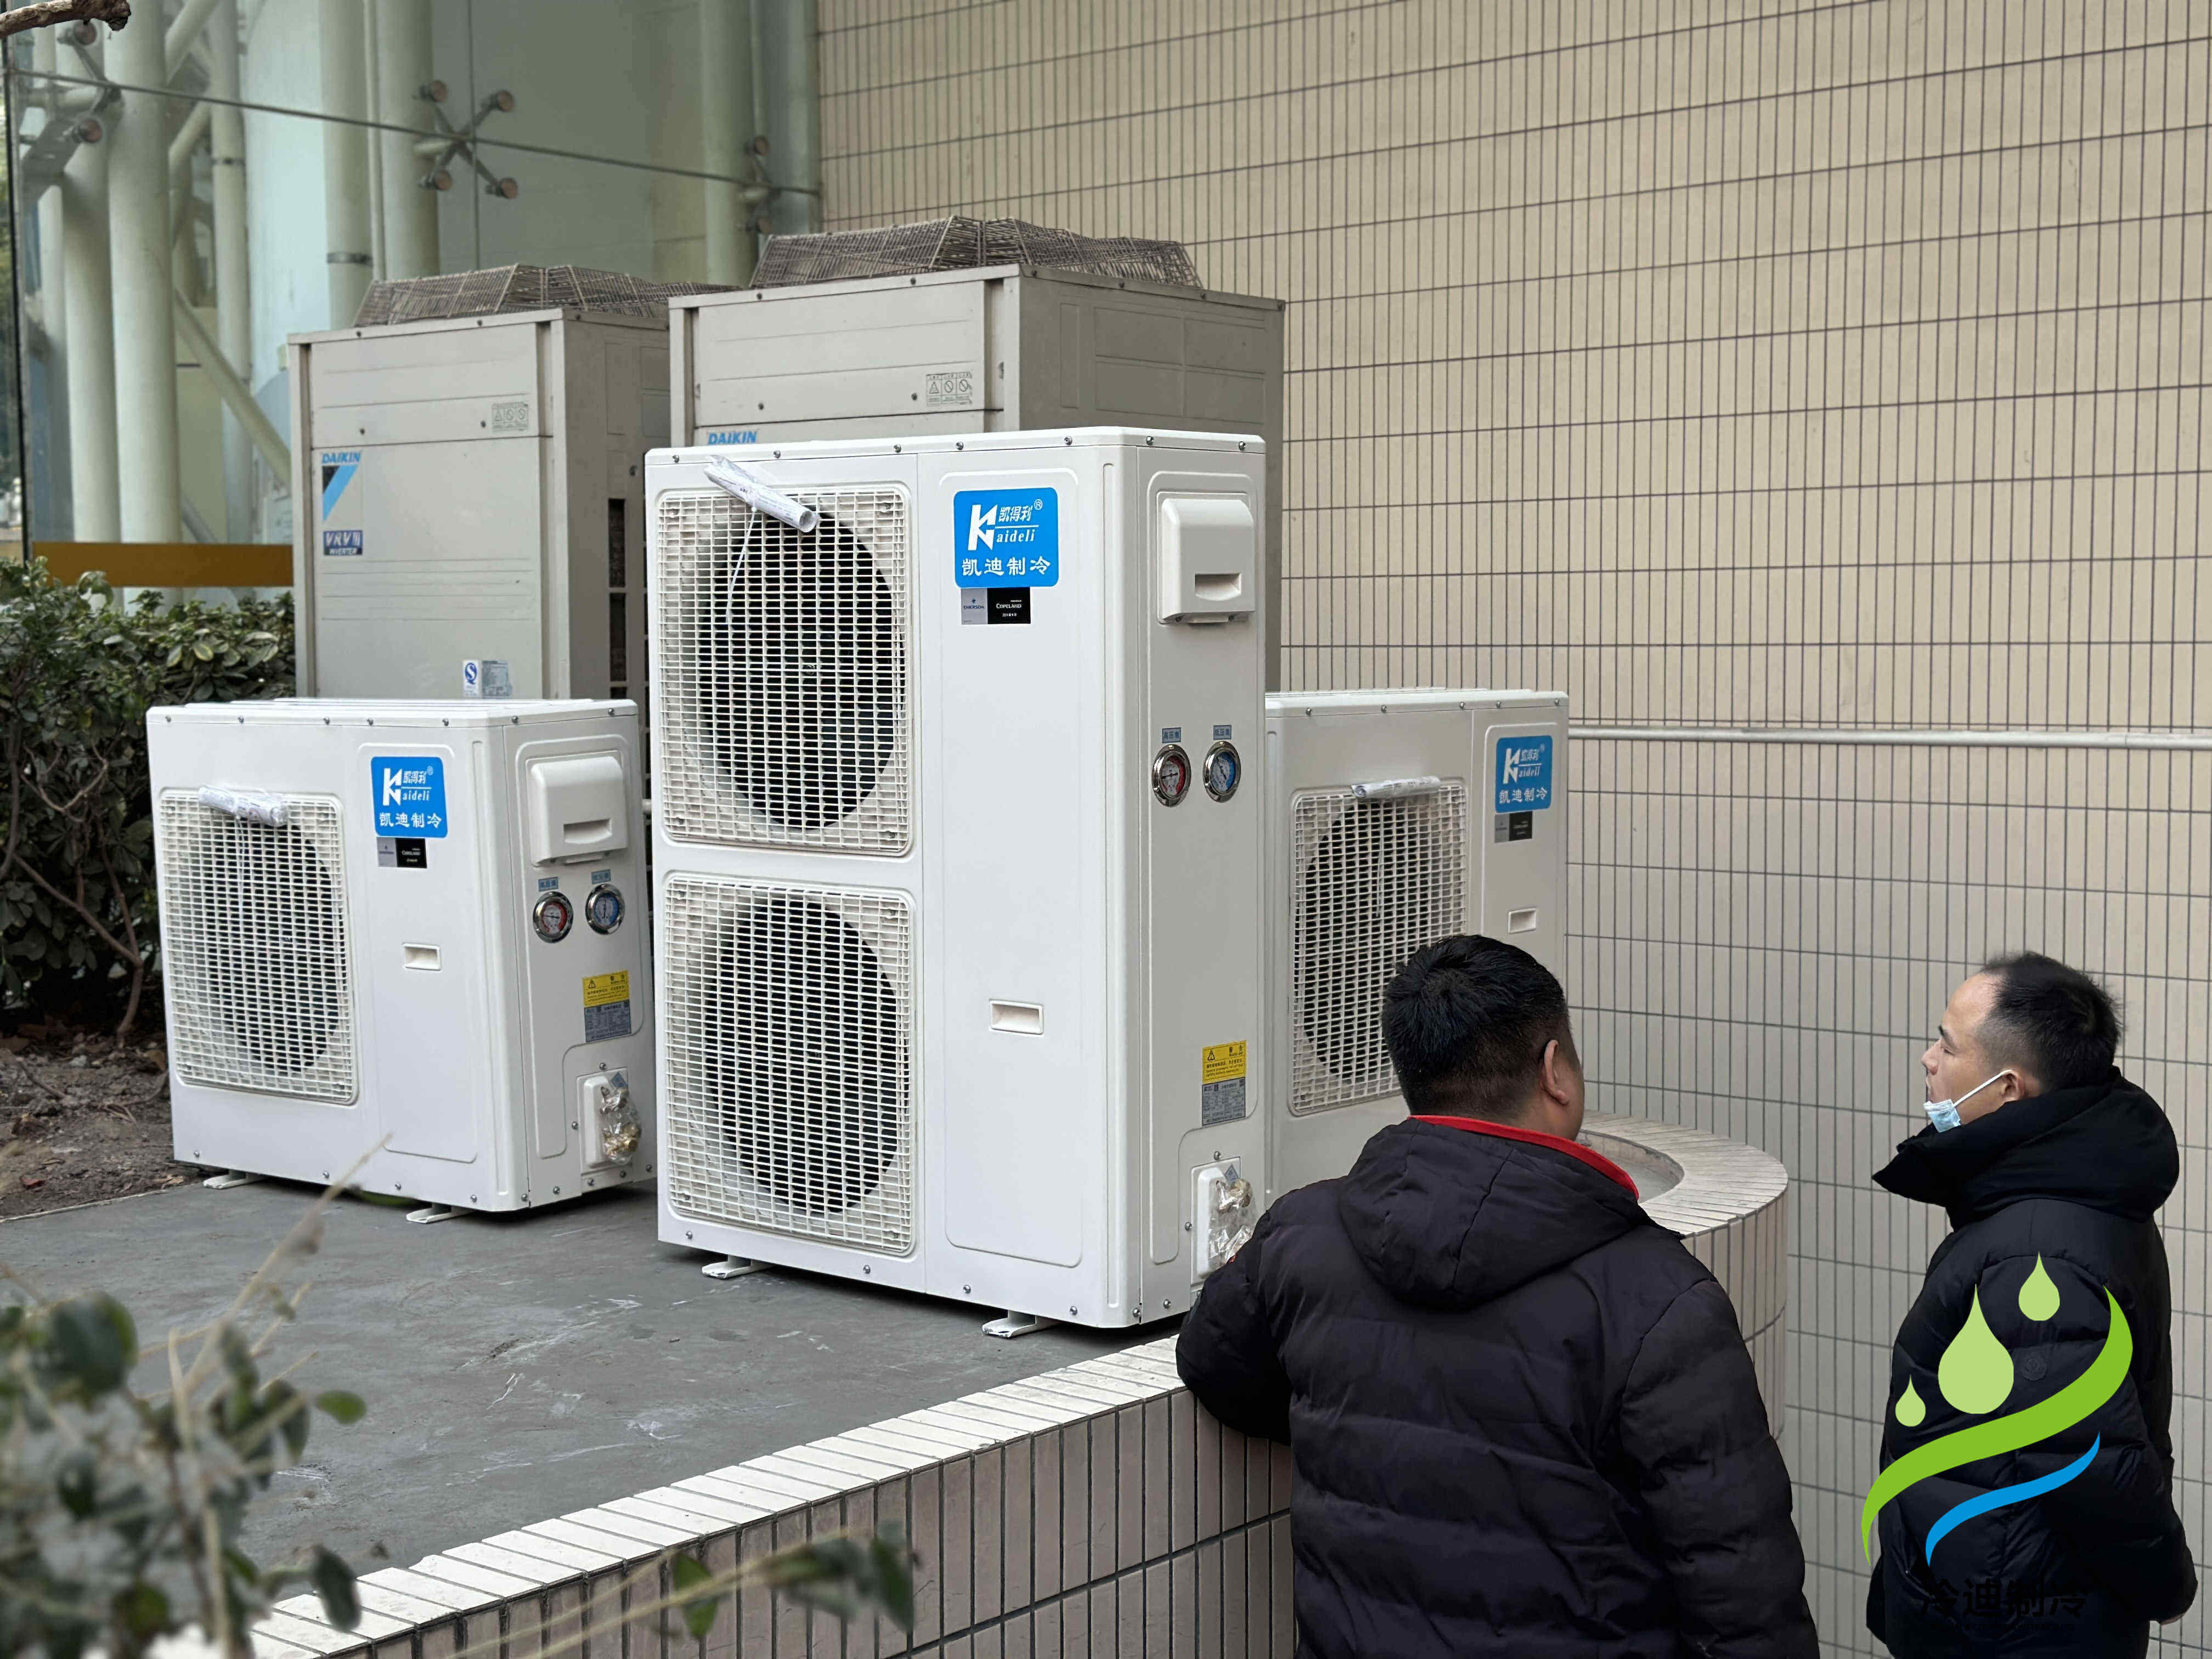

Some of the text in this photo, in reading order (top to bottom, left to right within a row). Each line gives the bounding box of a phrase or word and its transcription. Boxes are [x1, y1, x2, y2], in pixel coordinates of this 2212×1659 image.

[708, 430, 758, 445] DAIKIN
[322, 452, 361, 464] DAIKIN
[998, 505, 1033, 522] 凯得利
[962, 556, 1051, 576] 凯迪制冷
[379, 812, 442, 829] 凯迪制冷
